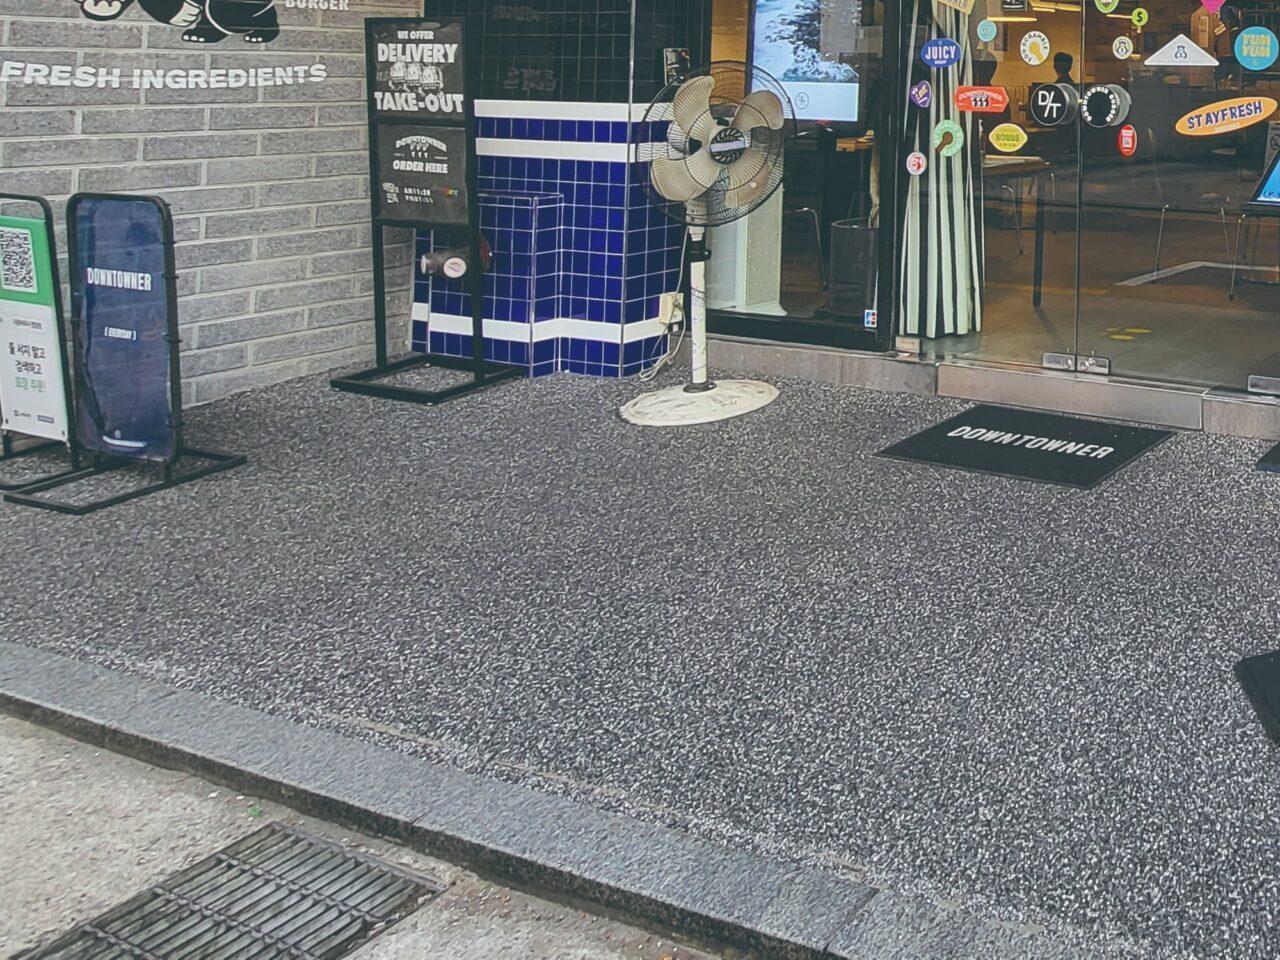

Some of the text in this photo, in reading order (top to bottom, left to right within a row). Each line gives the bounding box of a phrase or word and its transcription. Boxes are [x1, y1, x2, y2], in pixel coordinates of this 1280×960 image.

[409, 31, 434, 39] OFFER
[1022, 33, 1048, 51] SCRAMBLE
[377, 43, 458, 63] DELIVERY
[925, 45, 956, 60] JUICY
[1, 61, 327, 90] FRESH INGREDIENTS
[374, 92, 464, 113] TAKE-OUT
[1082, 86, 1109, 122] DOWNTOWNER
[396, 135, 447, 152] DOWNTOWNER
[393, 160, 448, 173] ORDER HERE
[87, 267, 152, 291] DOWNTOWNER
[947, 426, 1115, 459] DOWNTOWNER
